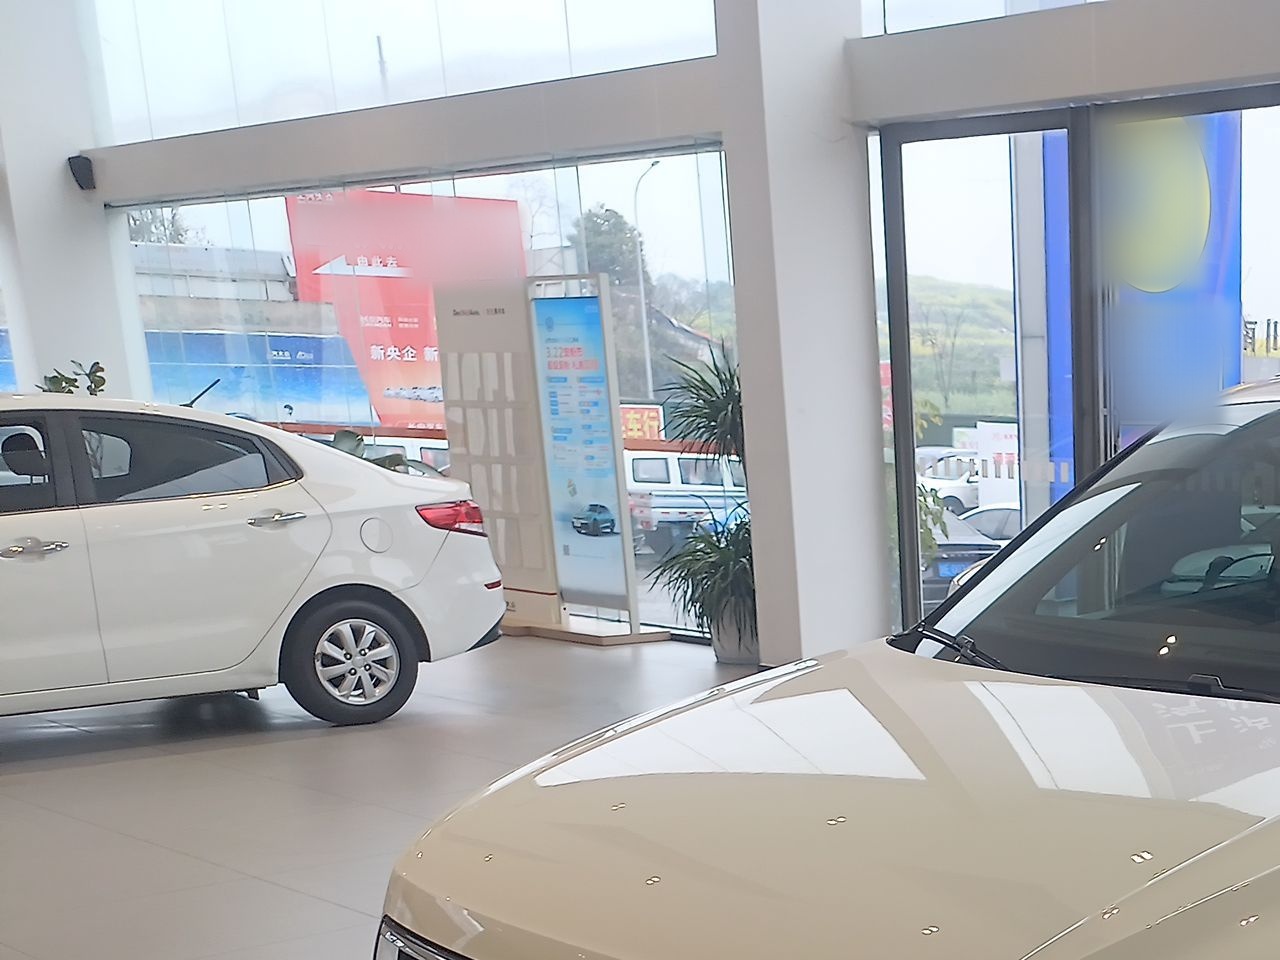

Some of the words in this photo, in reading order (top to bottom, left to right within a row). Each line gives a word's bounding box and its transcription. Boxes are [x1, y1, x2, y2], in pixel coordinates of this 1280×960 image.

[370, 340, 417, 361] 新央企
[423, 346, 439, 362] 新
[622, 408, 660, 440] 车行
